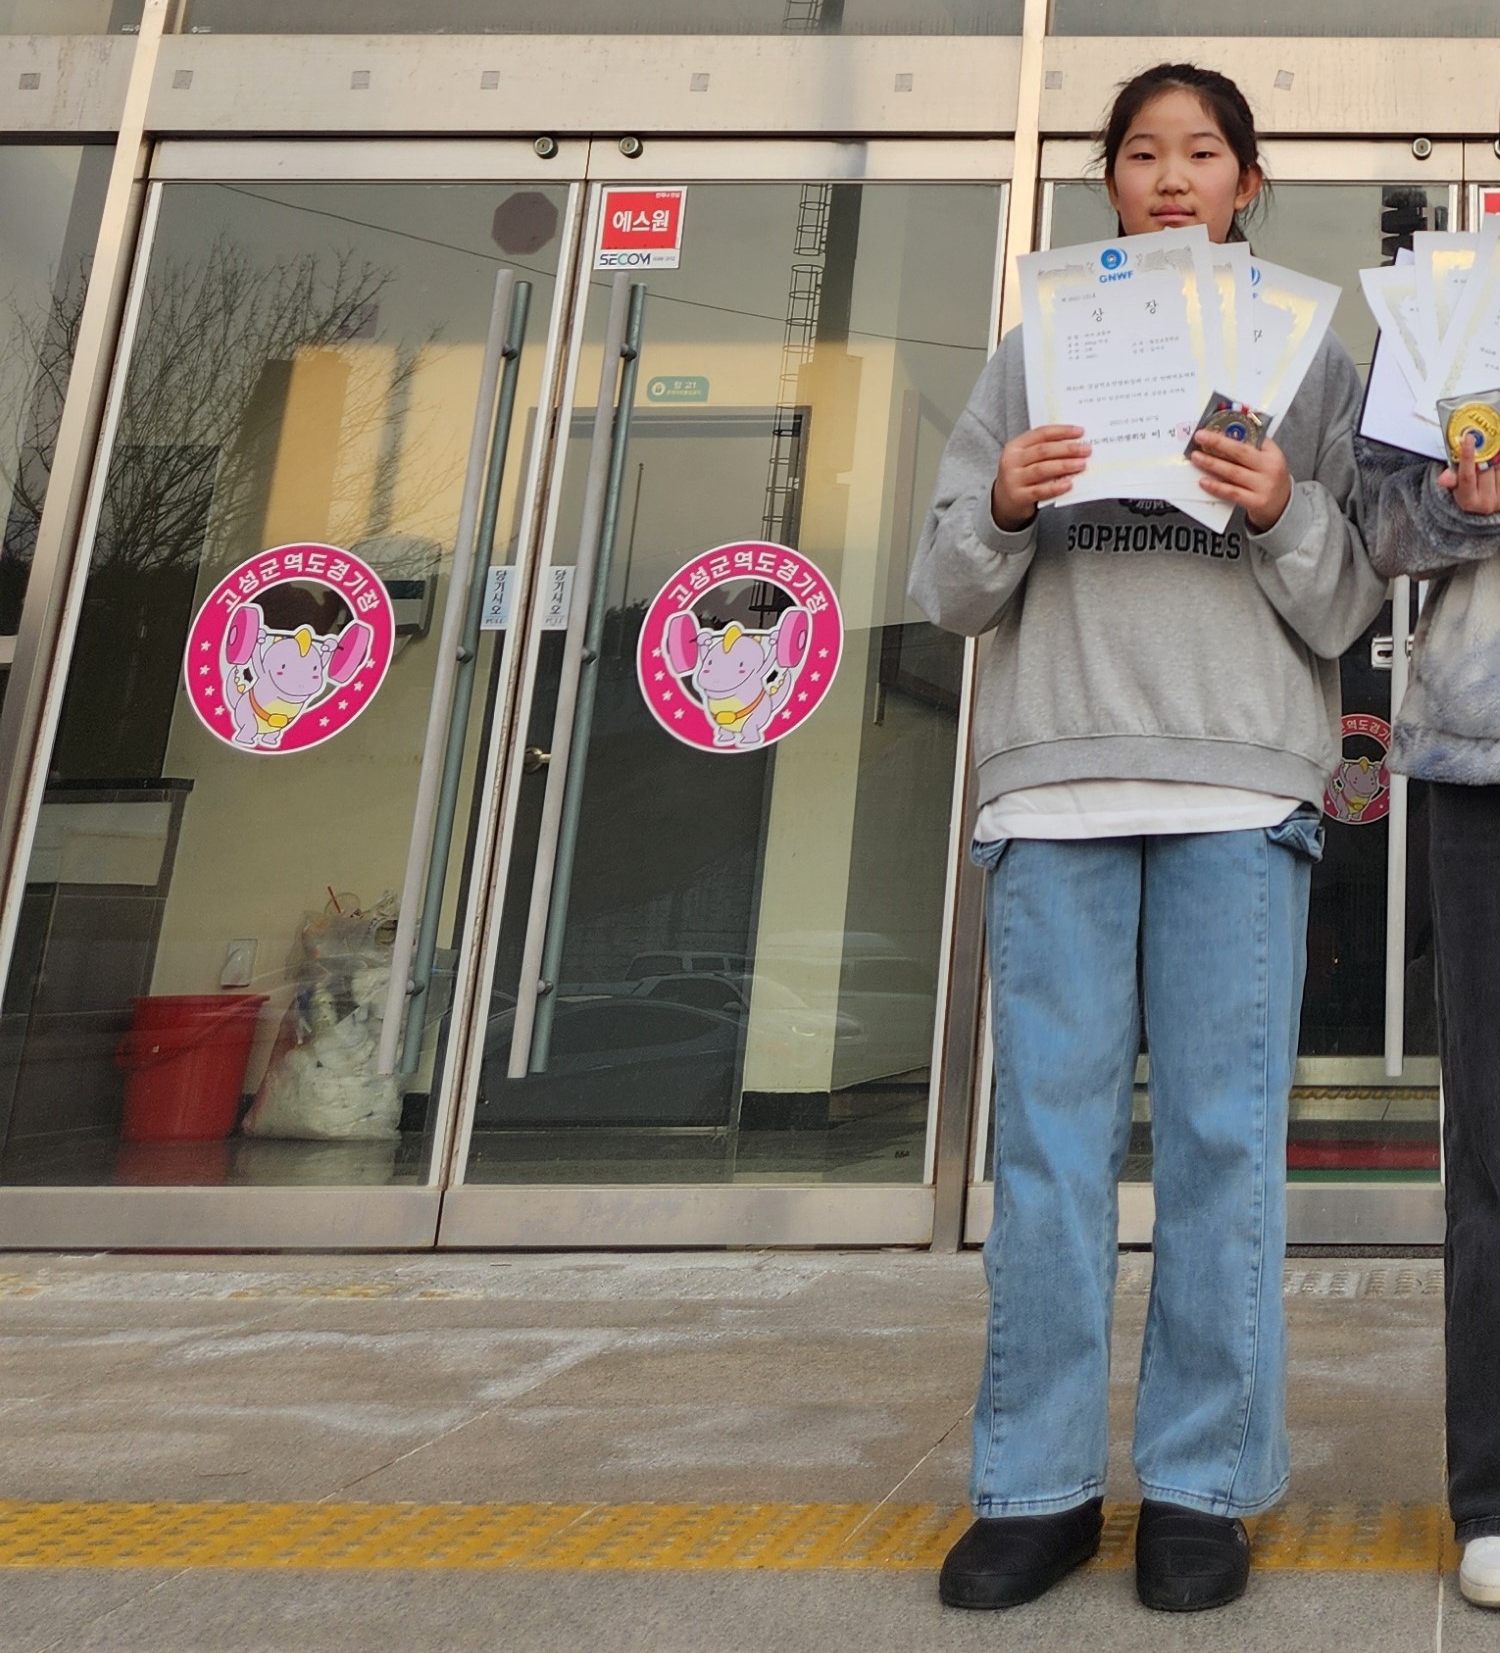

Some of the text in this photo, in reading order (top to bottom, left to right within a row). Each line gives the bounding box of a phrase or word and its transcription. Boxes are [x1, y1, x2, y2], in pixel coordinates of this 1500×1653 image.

[611, 209, 671, 233] 에스원
[599, 252, 652, 267] SECOM
[1098, 270, 1135, 284] GNWF
[1091, 299, 1159, 323] 상 장
[216, 551, 381, 614] 고성군역도경기장
[489, 569, 508, 615] 당기시오
[549, 569, 567, 615] 당기시오
[667, 550, 829, 615] 고성군역도경기장
